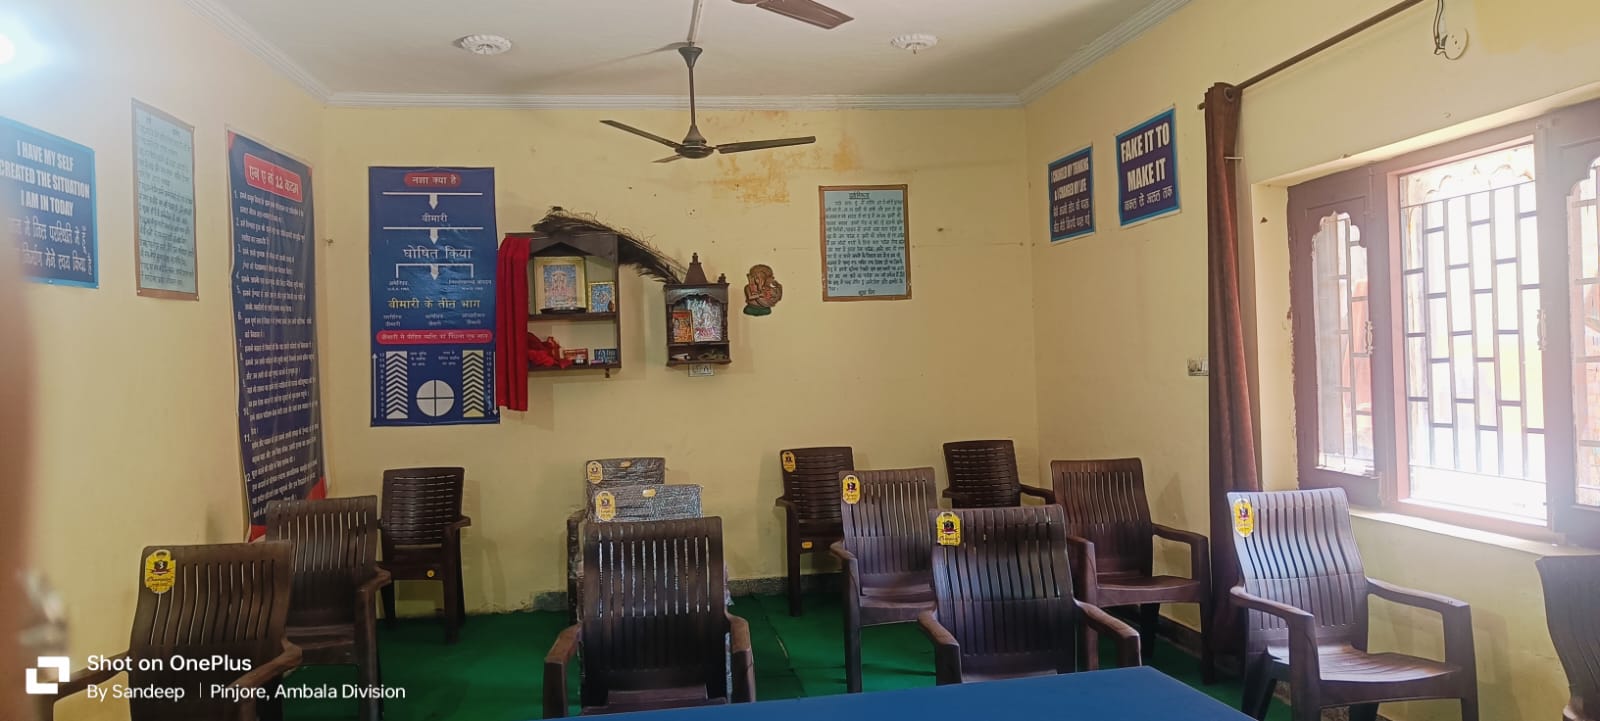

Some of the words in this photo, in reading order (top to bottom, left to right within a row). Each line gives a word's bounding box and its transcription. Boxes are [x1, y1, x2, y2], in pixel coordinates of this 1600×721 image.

[1120, 135, 1144, 163] FAKE
[1144, 129, 1154, 154] IT
[1155, 122, 1170, 148] TO
[16, 139, 21, 157] I
[22, 141, 43, 163] HAVE
[43, 148, 56, 167] MY
[56, 153, 74, 172] SELF
[0, 159, 36, 185] CREATED
[36, 169, 52, 189] THE
[52, 174, 90, 199] SITUATION
[275, 174, 284, 190] 12
[411, 175, 429, 185] नशा
[432, 175, 447, 185] क्या
[450, 174, 457, 185] है
[1127, 162, 1155, 193] MAKE
[1156, 157, 1166, 182] IT
[21, 189, 25, 207] I
[25, 190, 39, 209] AM
[40, 194, 49, 212] IN
[50, 197, 74, 217] TODAY
[1162, 185, 1173, 200] तक
[402, 244, 439, 260] घोषित
[444, 244, 472, 260] किया
[424, 297, 433, 310] के
[437, 297, 456, 310] तीन
[462, 299, 480, 309] भाग
